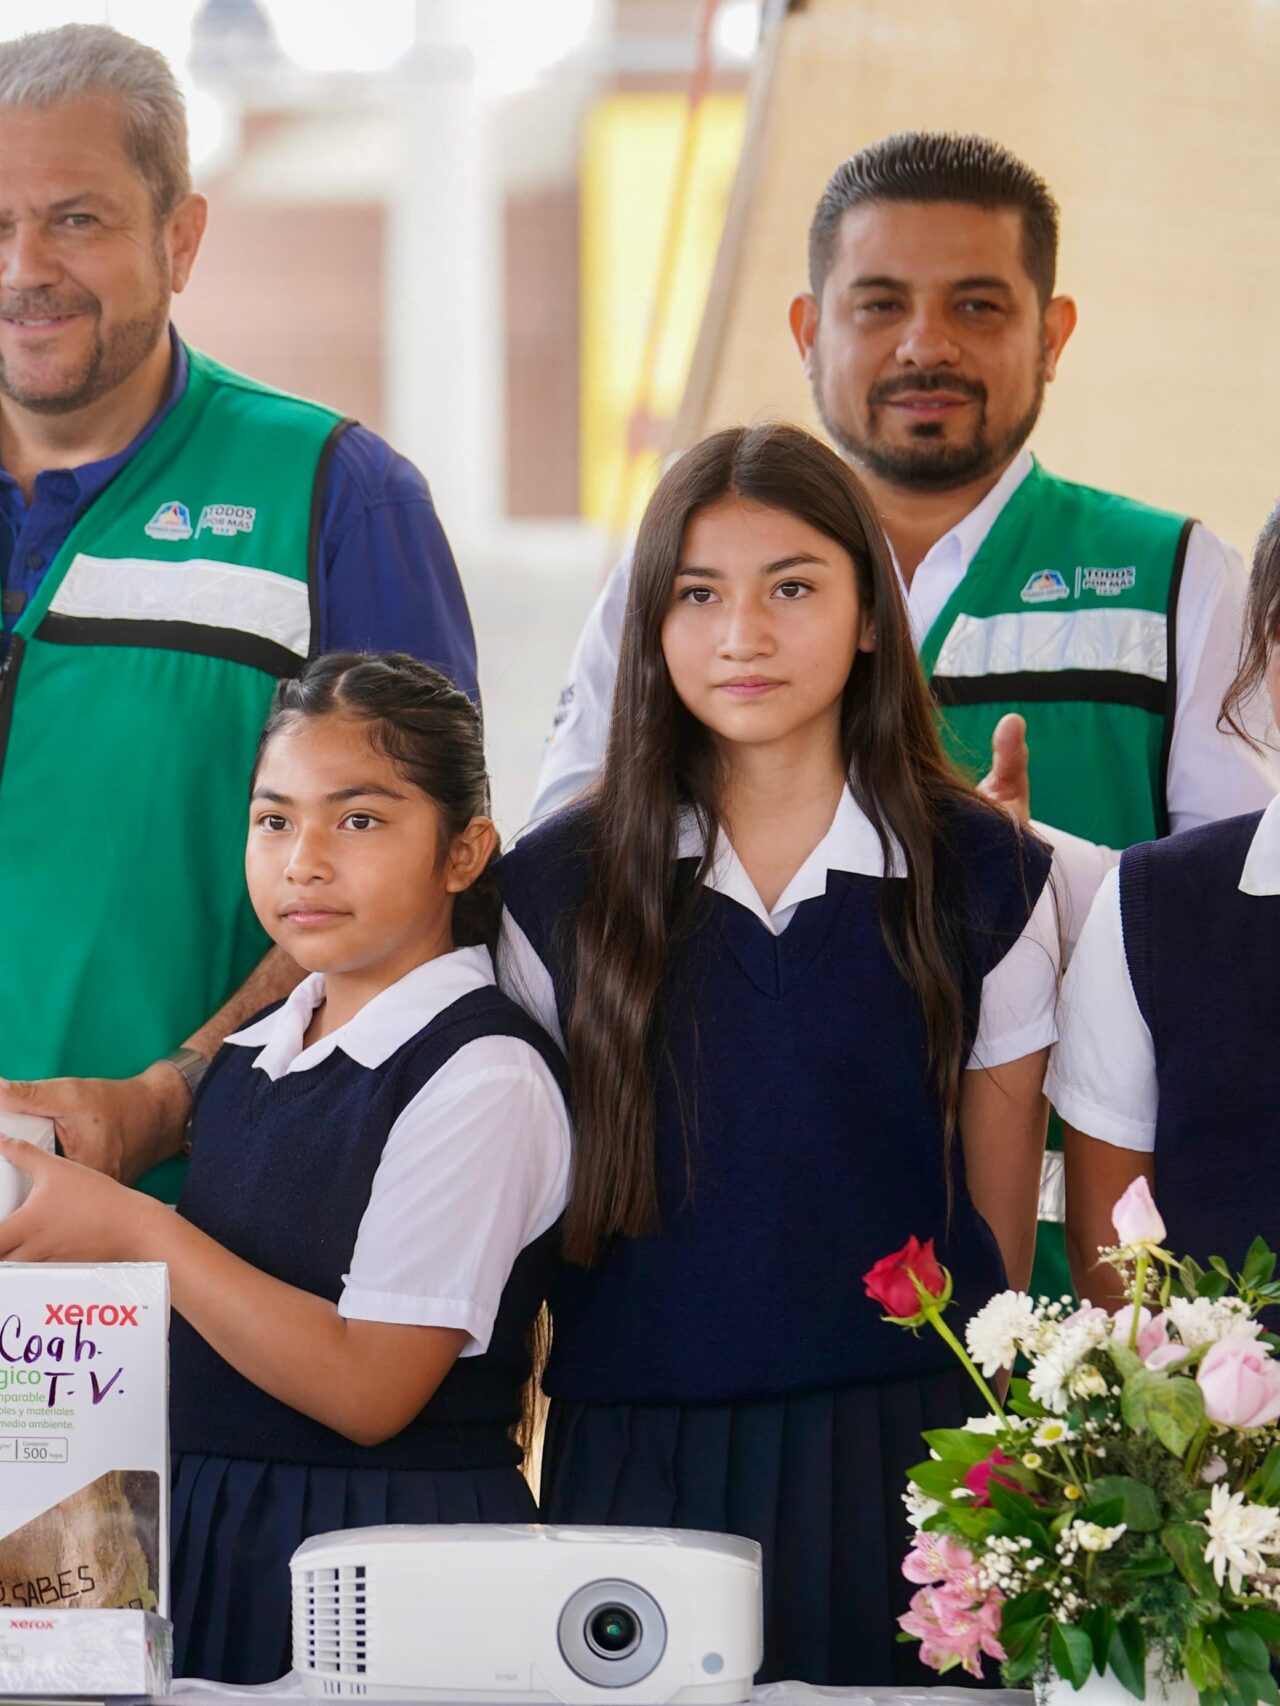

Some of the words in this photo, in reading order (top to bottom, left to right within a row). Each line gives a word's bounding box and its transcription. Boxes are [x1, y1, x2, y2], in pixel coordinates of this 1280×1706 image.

[208, 506, 253, 519] TODOS
[1086, 569, 1134, 579] TODOS
[44, 1304, 138, 1326] xerox
[19, 1407, 25, 1417] y
[26, 1407, 75, 1416] materiales
[23, 1447, 48, 1459] 500
[9, 1619, 55, 1630] xerox
